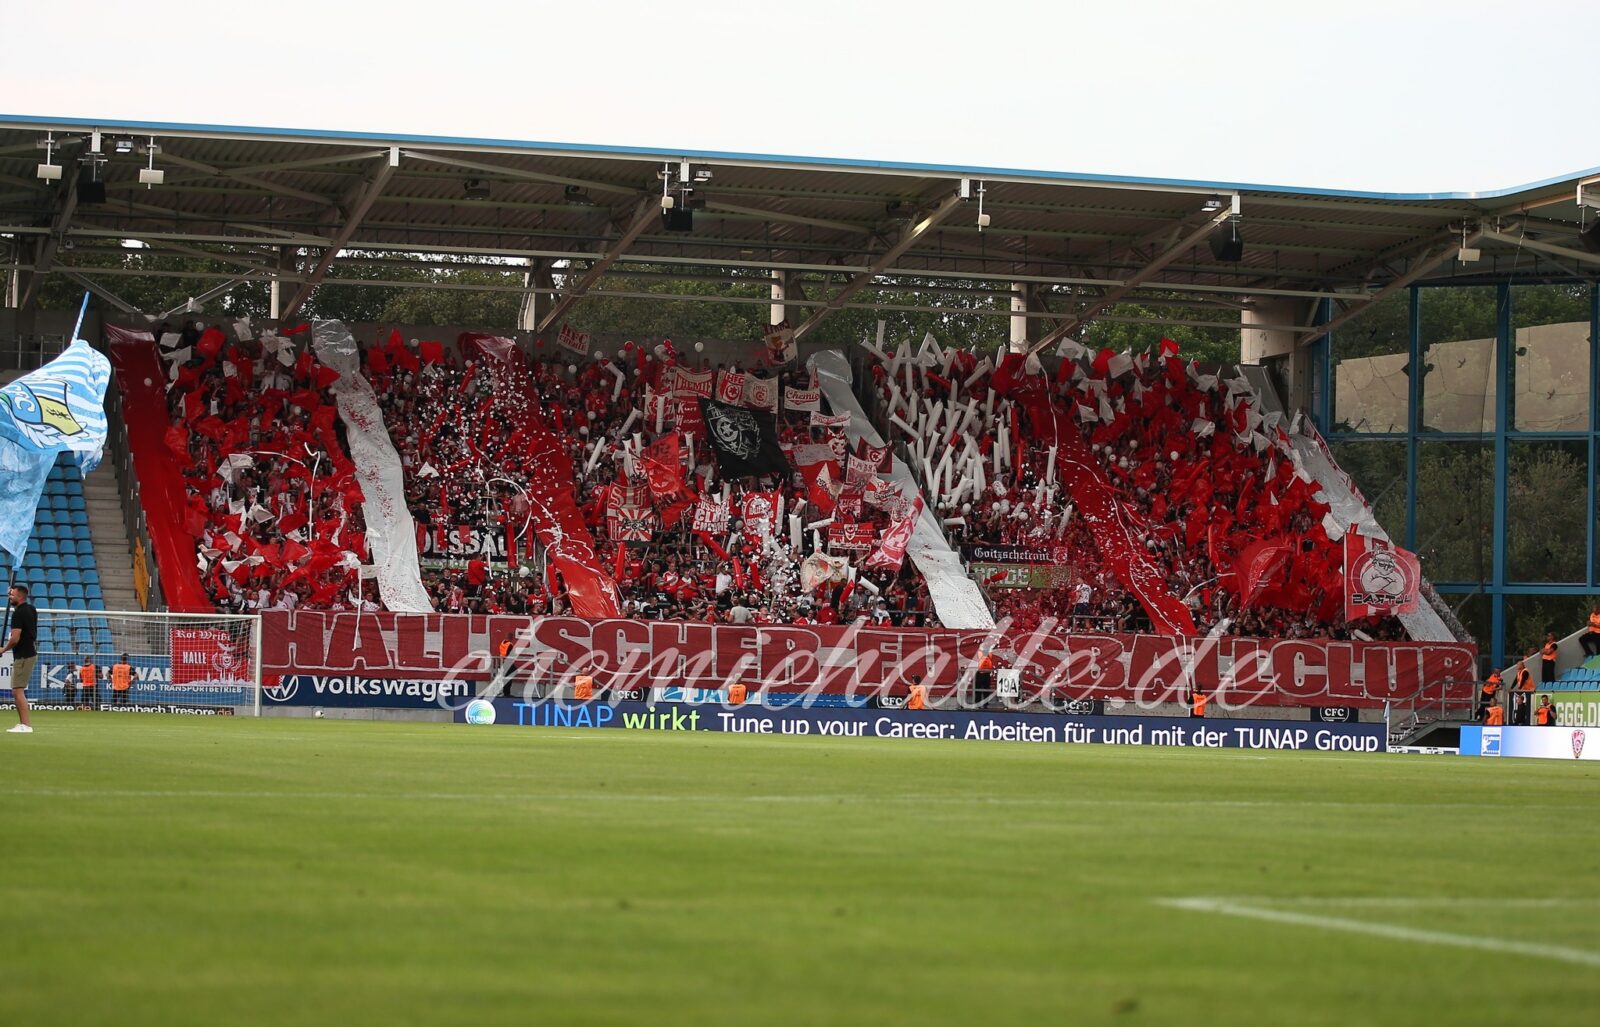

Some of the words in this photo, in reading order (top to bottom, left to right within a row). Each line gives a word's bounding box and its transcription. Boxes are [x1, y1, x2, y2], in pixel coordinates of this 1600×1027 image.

[725, 372, 745, 384] HFC
[786, 390, 819, 401] Chemie
[176, 630, 196, 640] Rot
[258, 609, 823, 686] HALLESCHER
[183, 651, 207, 664] HALLE
[137, 683, 157, 692] UND
[160, 684, 242, 693] TRANSPORTBETRIEB
[311, 675, 469, 702] Volkswagen
[998, 677, 1018, 693] 19A
[617, 690, 639, 700] CFC
[881, 697, 904, 706] CFC
[100, 704, 165, 715] Eisenbach
[1324, 707, 1345, 718] CFC
[1556, 701, 1600, 726] GGG.D
[513, 703, 614, 728] TUNAP
[717, 712, 773, 734] Tune
[781, 719, 810, 736] up
[817, 720, 868, 737] your
[875, 717, 955, 740] Career:
[964, 719, 1056, 743] Arbeiten
[1063, 722, 1095, 744] für
[1103, 724, 1142, 745] und
[1151, 725, 1185, 746] mit
[1192, 726, 1228, 747] der
[1234, 727, 1308, 750] TUNAP
[1314, 729, 1379, 753] Group
